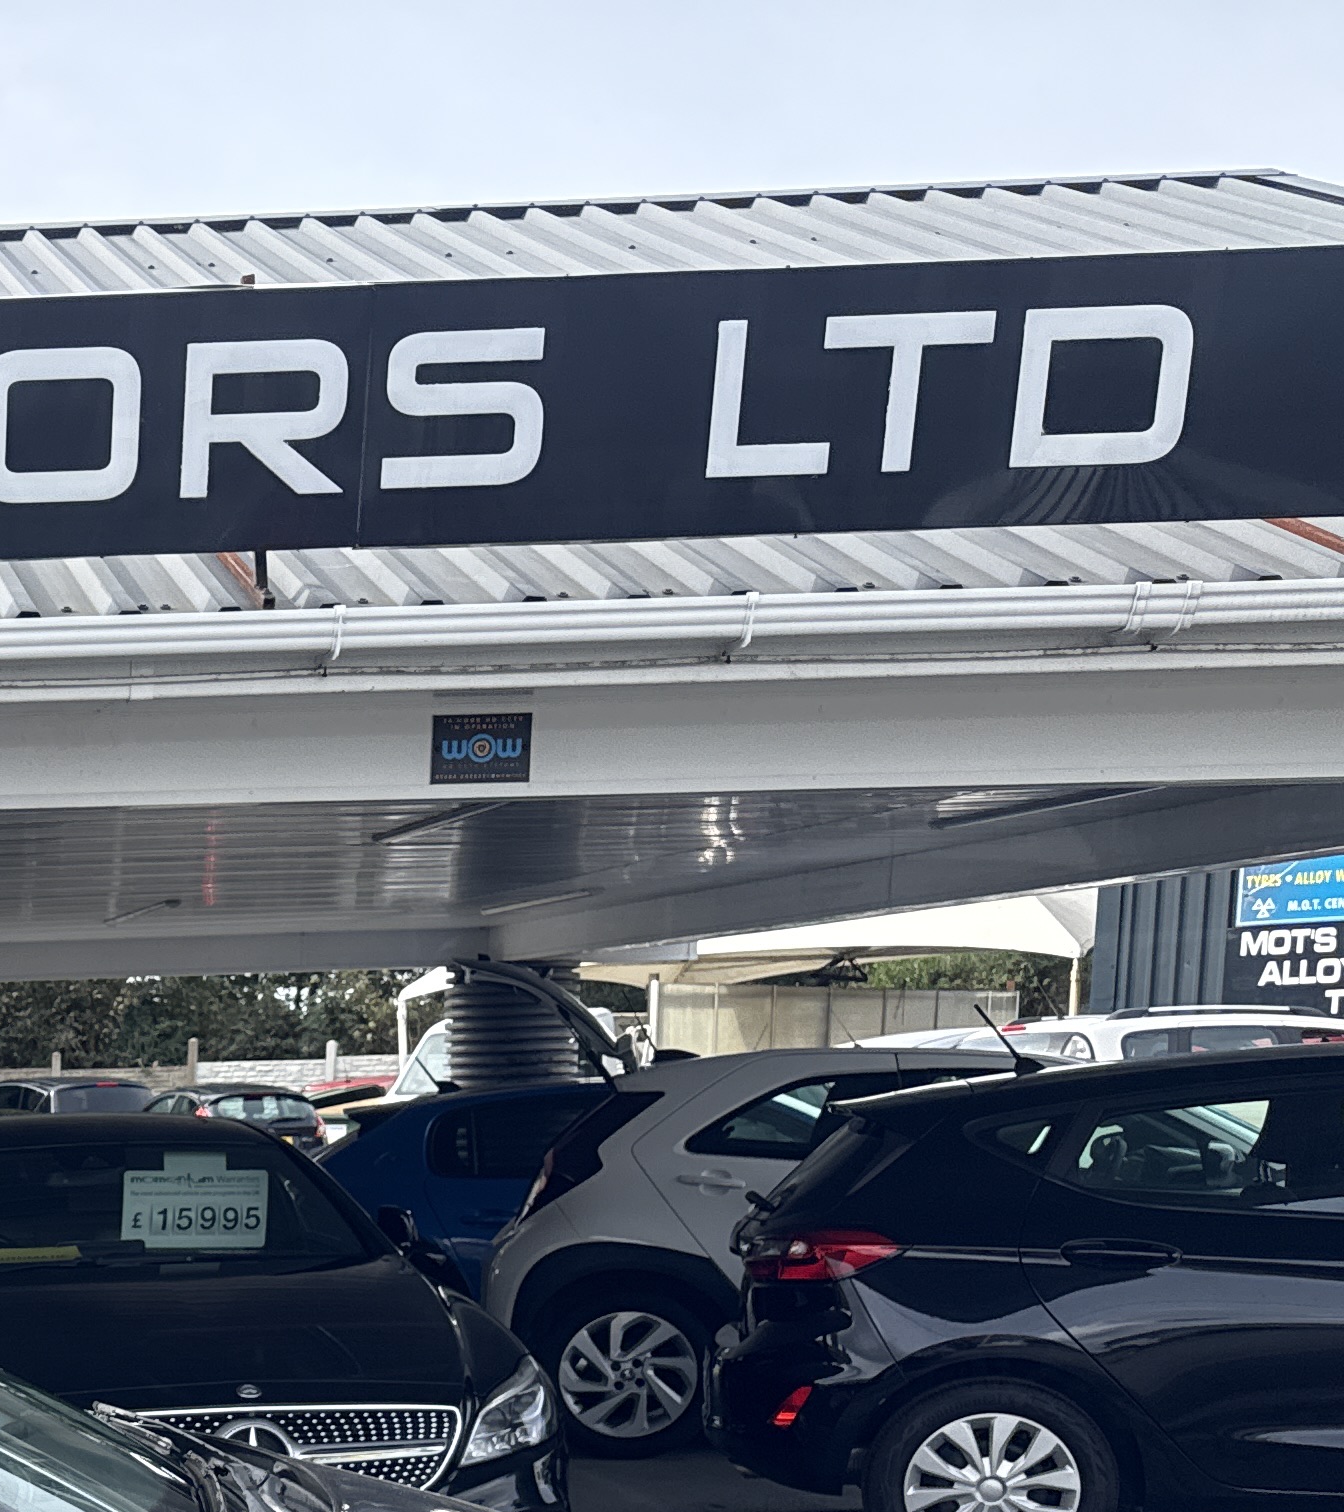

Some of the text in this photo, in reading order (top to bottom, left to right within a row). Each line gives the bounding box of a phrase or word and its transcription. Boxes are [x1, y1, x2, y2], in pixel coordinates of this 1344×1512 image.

[705, 304, 1194, 479] LTD
[1294, 869, 1333, 886] ALLOY
[1239, 927, 1338, 957] MOT'S
